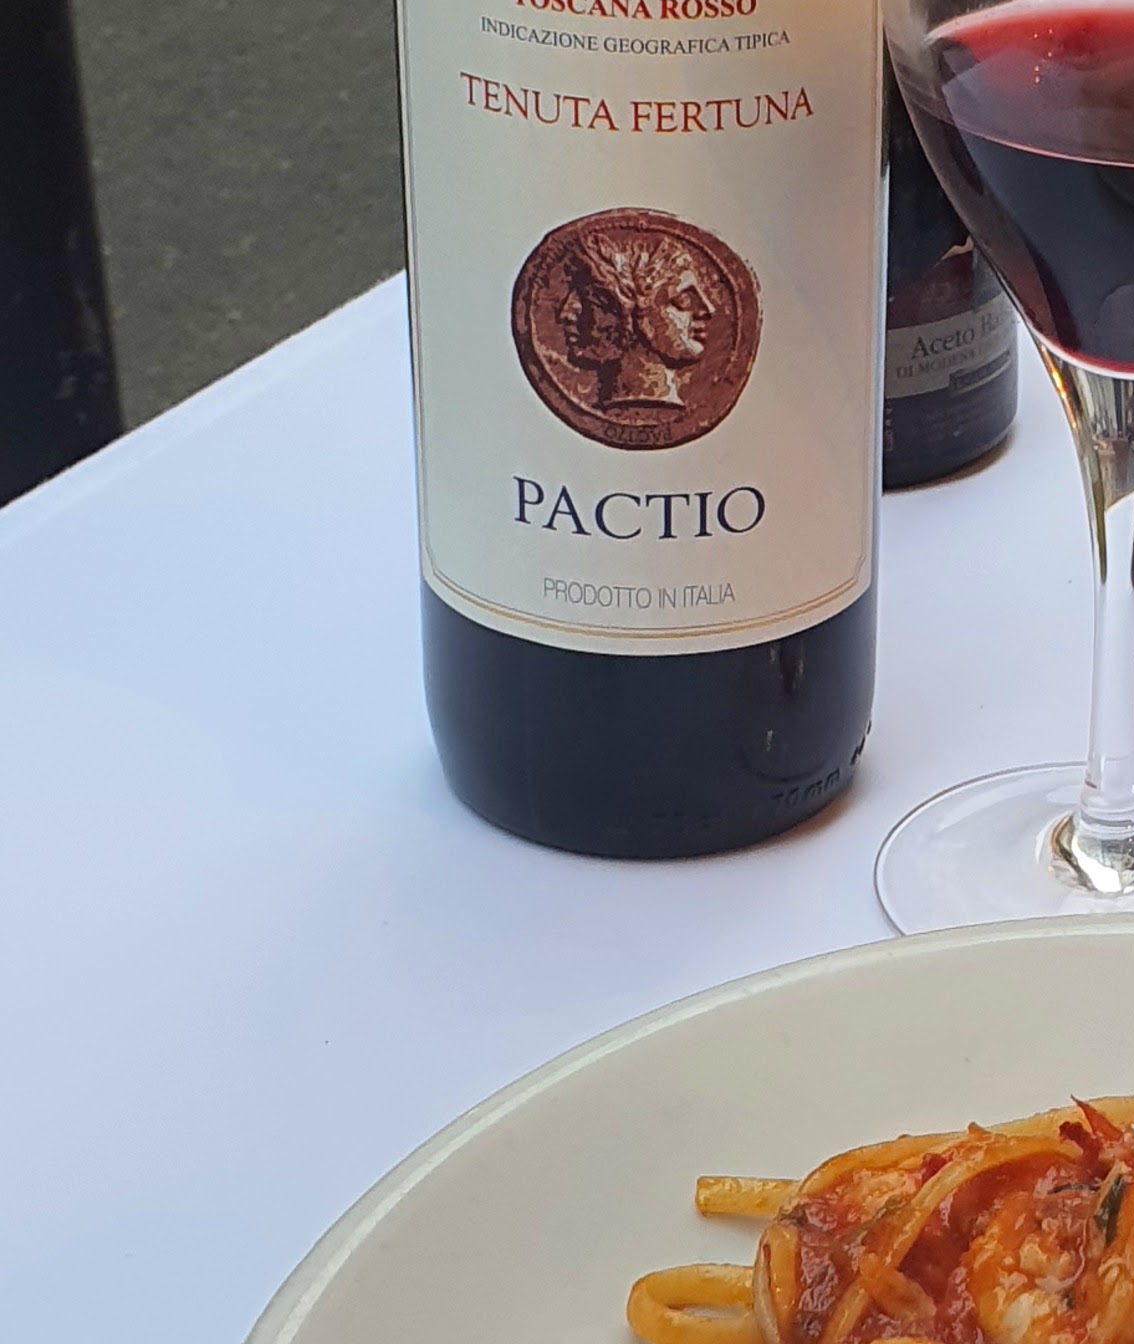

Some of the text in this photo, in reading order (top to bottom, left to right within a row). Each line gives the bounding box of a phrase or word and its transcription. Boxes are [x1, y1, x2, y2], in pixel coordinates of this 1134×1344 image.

[480, 16, 791, 55] INDICAZIONE GEOGRAFICA TIPICA
[459, 71, 815, 134] TENUTA FERTUNA
[911, 328, 975, 359] Aceto
[512, 475, 766, 540] PACTIO
[542, 577, 736, 609] PRODOTTO IN ITALIA
